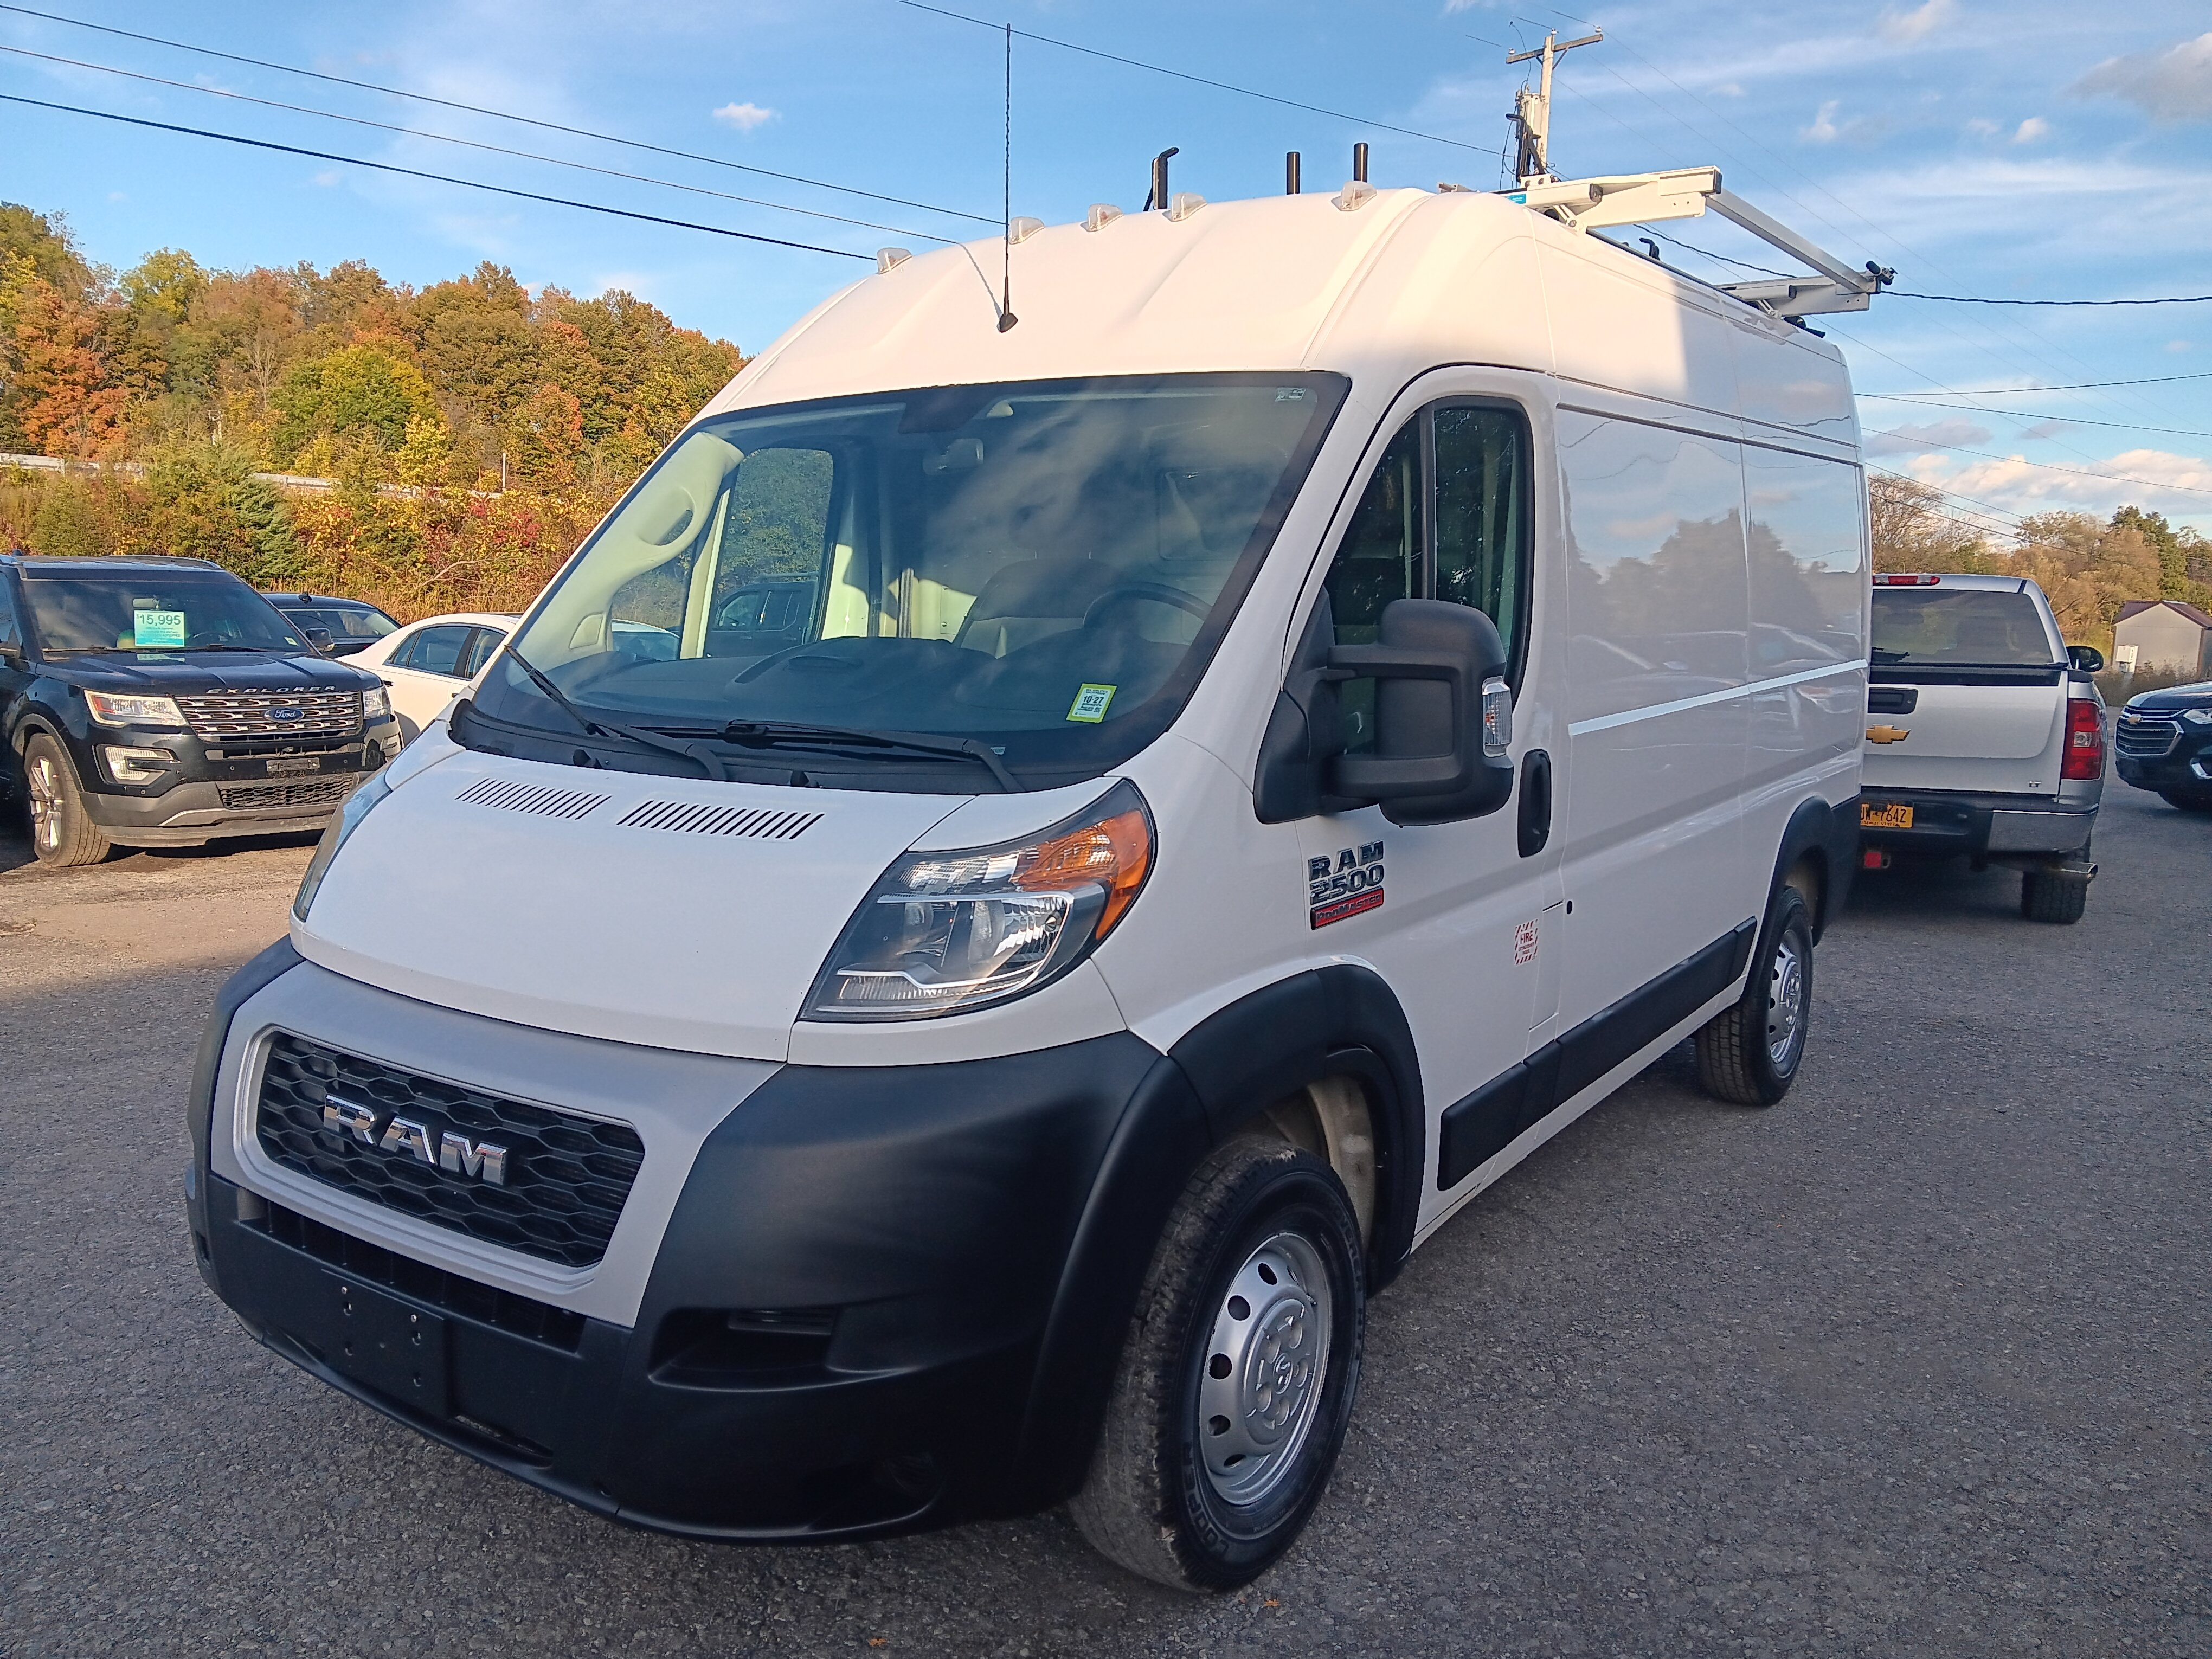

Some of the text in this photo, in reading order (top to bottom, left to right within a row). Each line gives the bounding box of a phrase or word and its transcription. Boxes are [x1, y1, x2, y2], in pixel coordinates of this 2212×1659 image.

[136, 614, 181, 626] $15,995
[274, 709, 296, 718] Ford
[1308, 840, 1384, 882] RAM
[1309, 863, 1385, 906] 2500
[1520, 930, 1533, 944] FIRE
[323, 1094, 507, 1186] RAM
